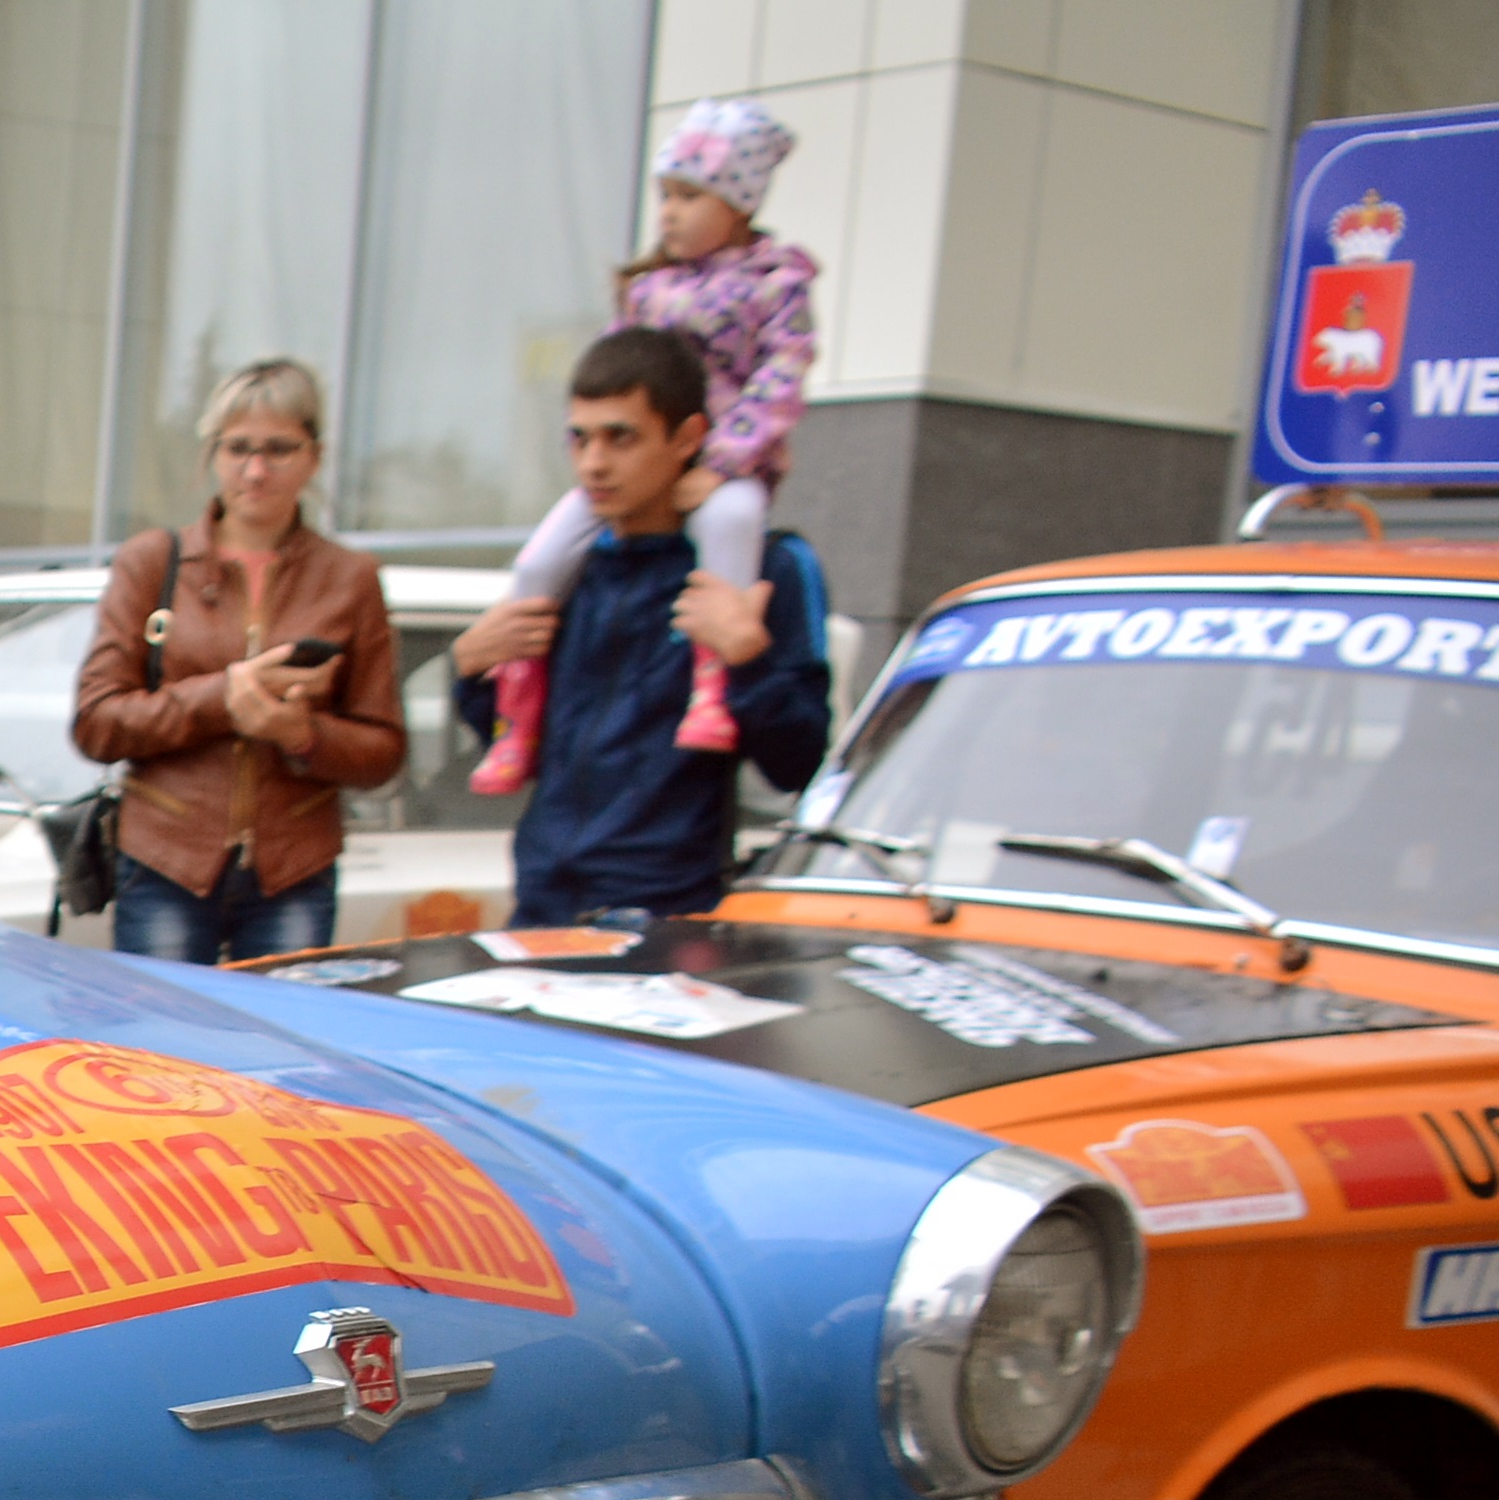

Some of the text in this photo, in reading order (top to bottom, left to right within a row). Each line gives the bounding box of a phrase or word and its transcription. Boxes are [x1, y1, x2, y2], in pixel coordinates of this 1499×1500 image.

[1412, 357, 1499, 418] WE
[963, 606, 1499, 680] AVTOEXPOR
[260, 1130, 550, 1290] PARIS
